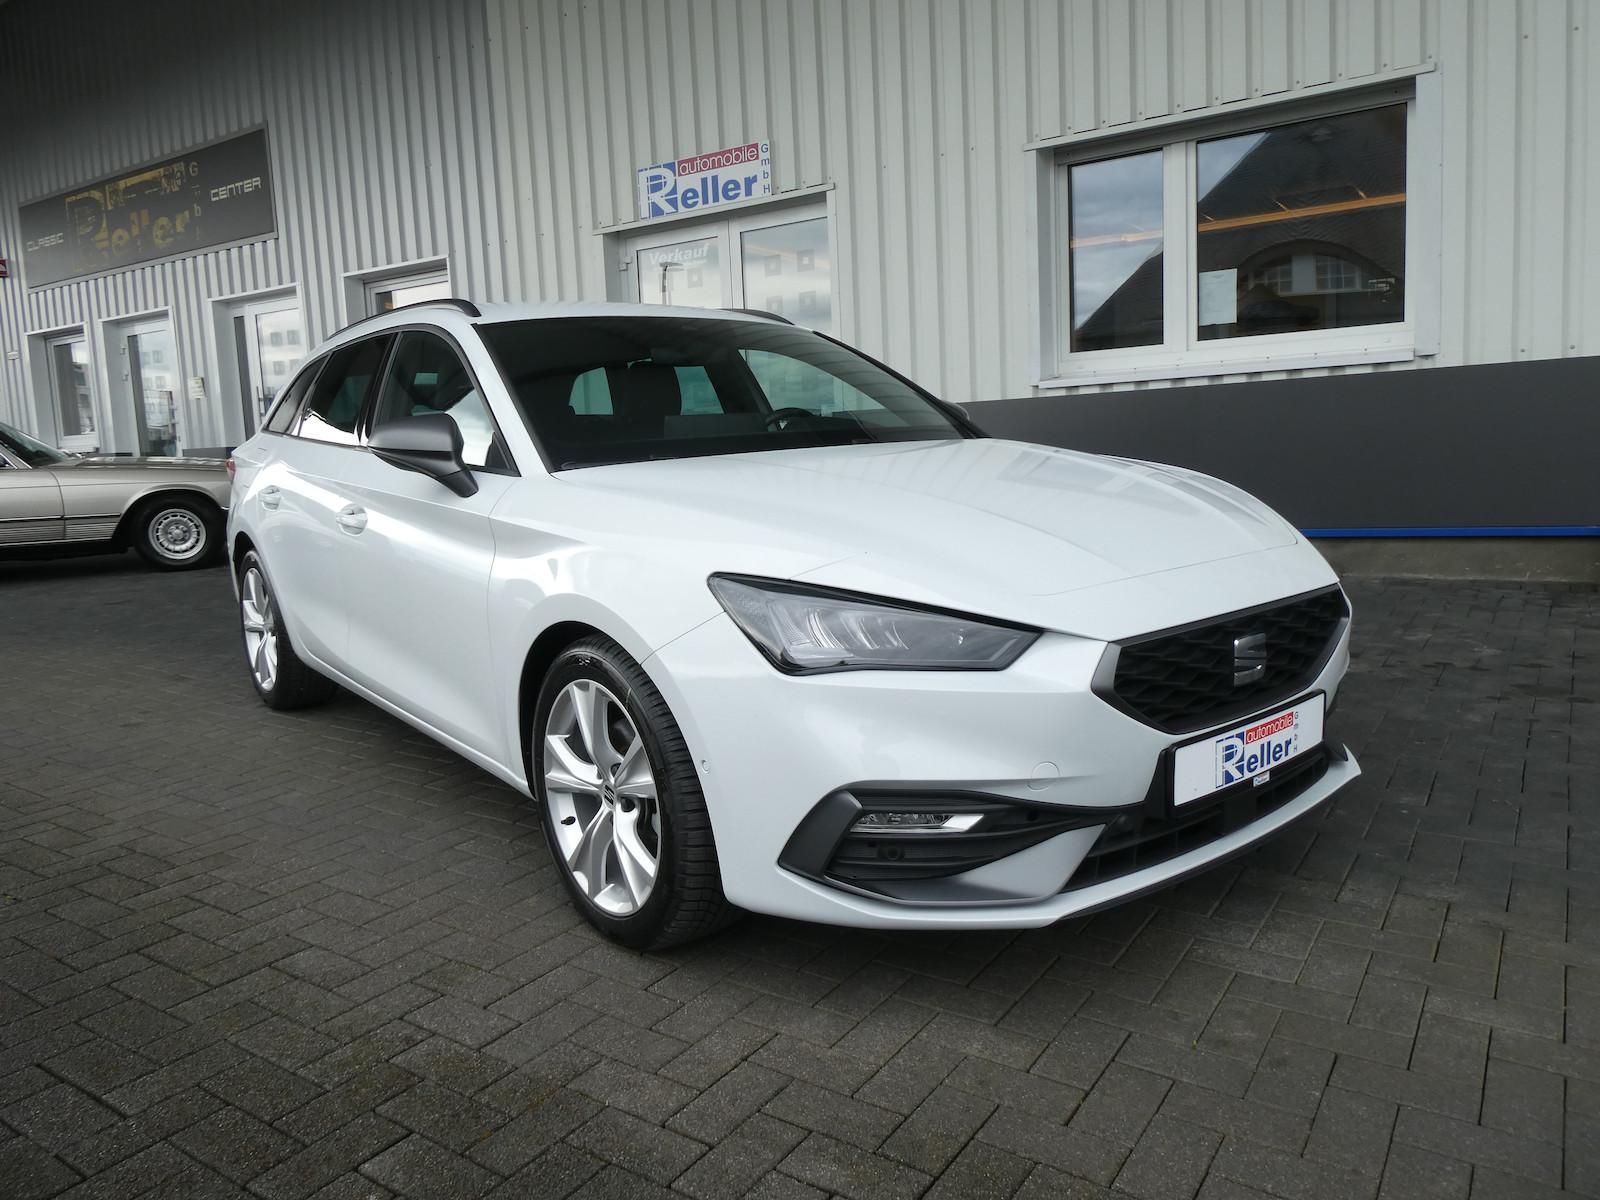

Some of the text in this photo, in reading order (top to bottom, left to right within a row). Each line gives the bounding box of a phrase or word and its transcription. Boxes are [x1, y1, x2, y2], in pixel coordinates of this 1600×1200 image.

[679, 146, 757, 176] automobile
[210, 176, 262, 202] CENTER
[638, 163, 758, 218] Reller
[648, 243, 710, 265] Verkauf
[1246, 714, 1294, 743] automobile
[1216, 735, 1292, 788] Reller
